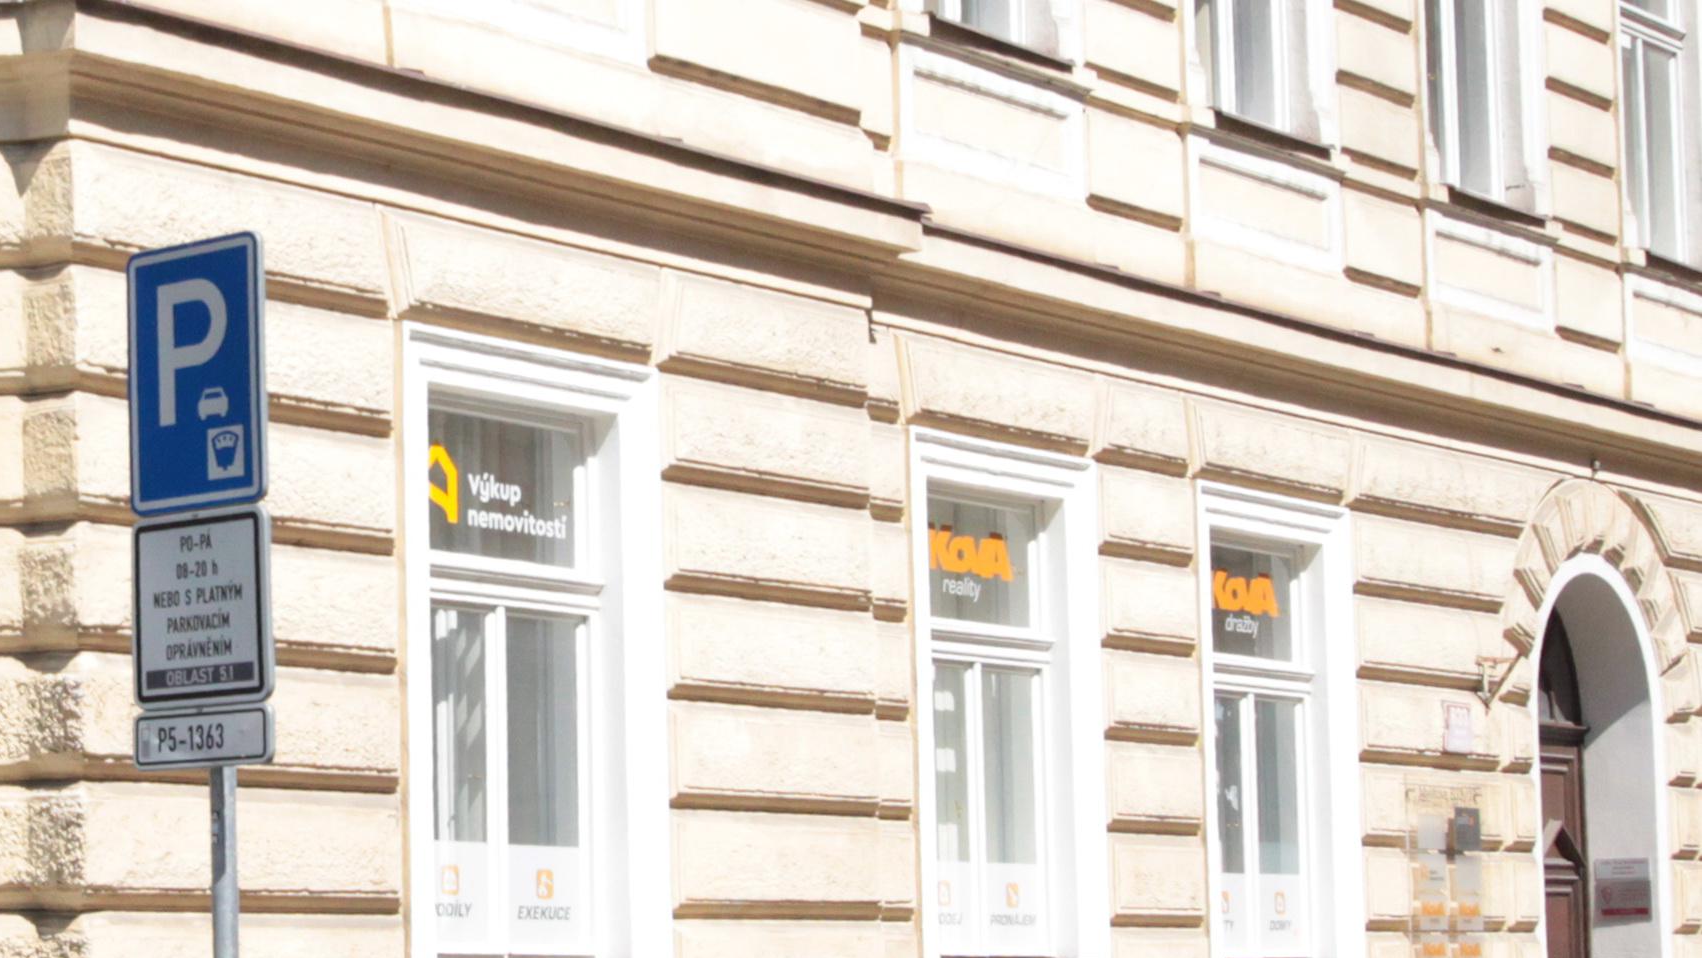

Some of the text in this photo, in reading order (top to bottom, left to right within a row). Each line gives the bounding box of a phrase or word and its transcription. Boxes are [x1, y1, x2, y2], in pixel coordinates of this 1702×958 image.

[155, 277, 228, 428] P
[467, 472, 522, 507] Výkup
[467, 509, 568, 540] nemovitostí
[179, 528, 213, 553] PO-PÁ
[176, 559, 219, 580] 08-20 h
[153, 580, 243, 609] NEBO S PLATNÝM
[942, 576, 982, 603] reality
[166, 608, 231, 634] PARKOVACÍM
[165, 634, 233, 661] OPRÁVNĚNÍM
[165, 667, 214, 687] OBLAST
[157, 722, 225, 753] P5-1363
[517, 904, 572, 921] EXEKUCE
